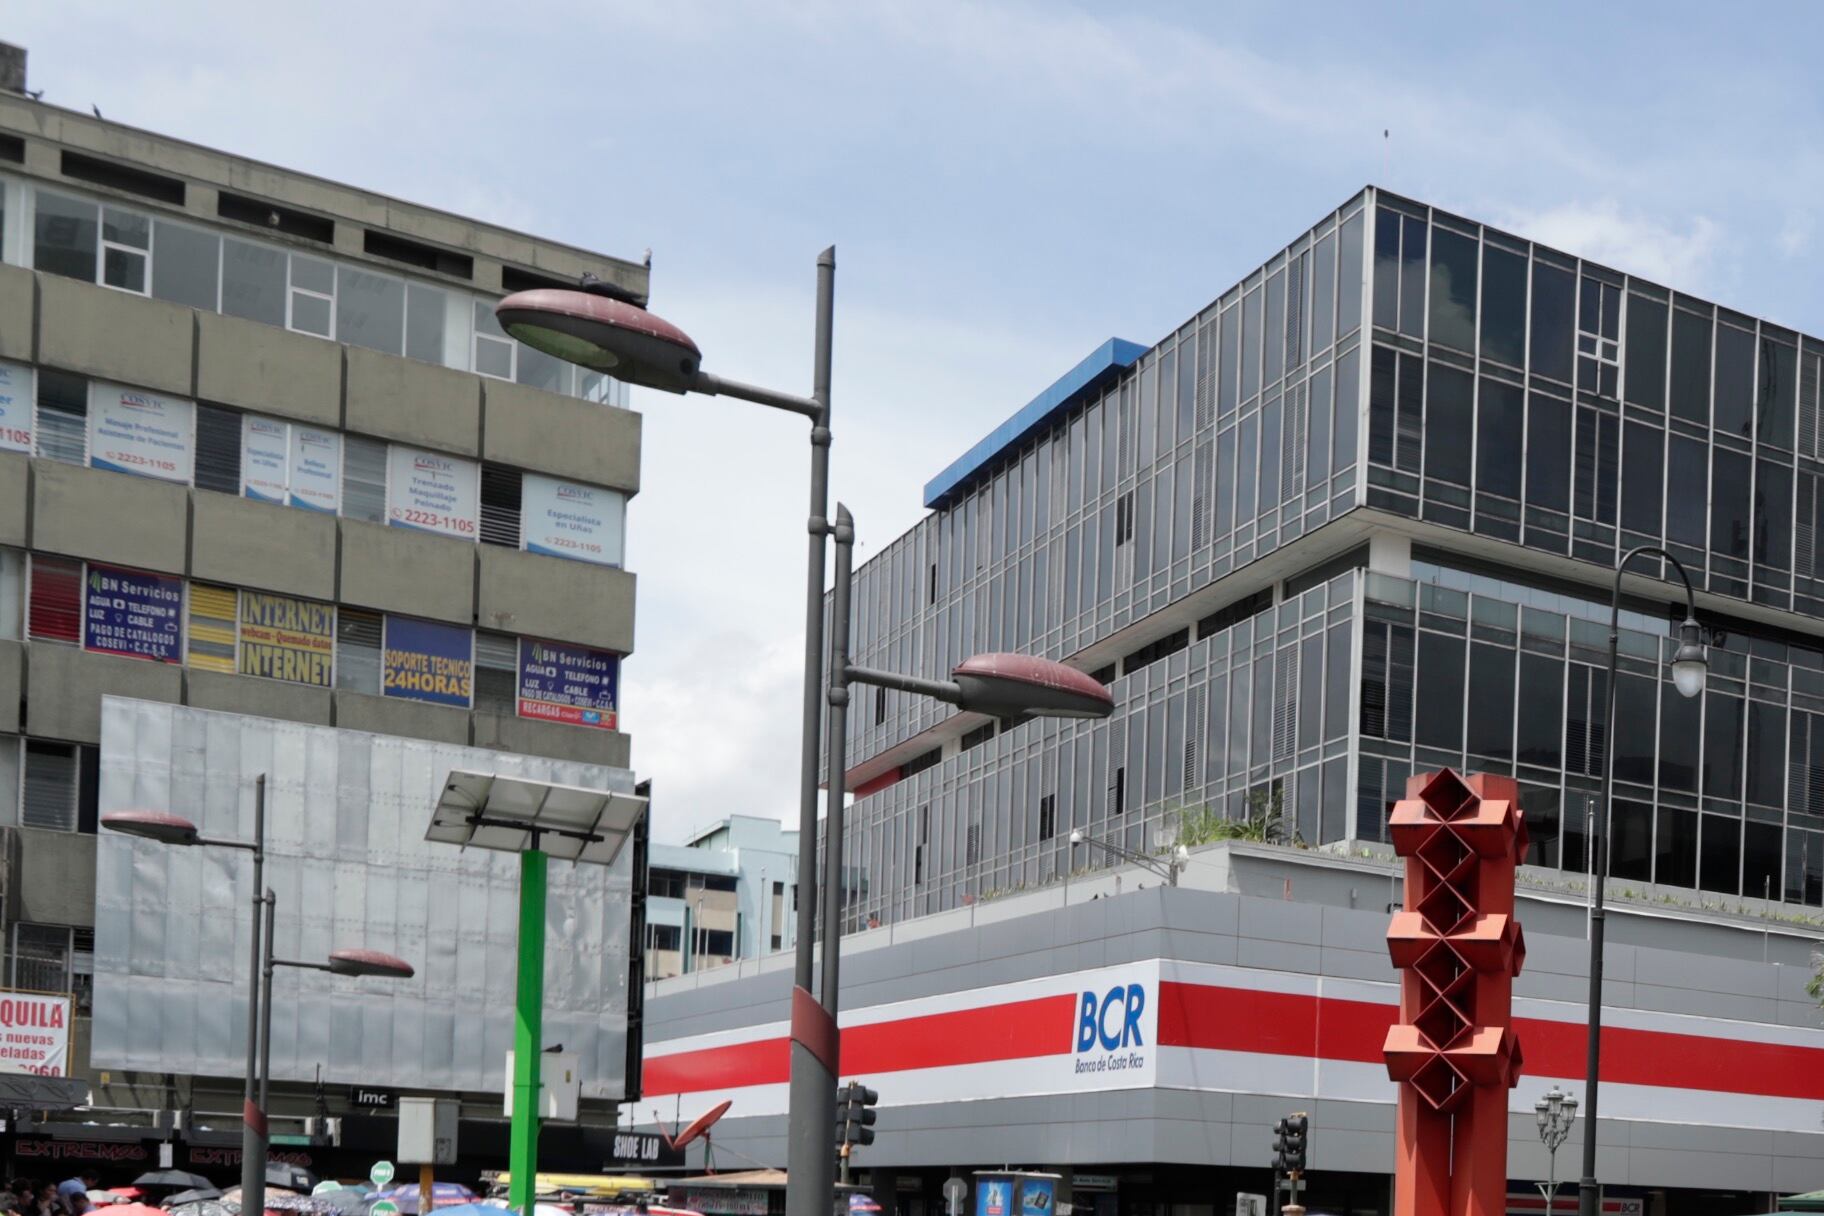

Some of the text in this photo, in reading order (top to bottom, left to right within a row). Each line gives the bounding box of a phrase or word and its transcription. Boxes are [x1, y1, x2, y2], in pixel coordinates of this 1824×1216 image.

[117, 452, 176, 471] 2223-1105
[405, 509, 474, 533] 2223-1105
[547, 509, 601, 526] Especialista
[102, 577, 179, 602] BN Servicios
[89, 595, 166, 617] AGUA TELEFONO
[242, 592, 333, 636] INTERNET
[89, 609, 154, 628] LUZ CABLE
[90, 623, 112, 636] PAGO
[114, 627, 125, 638] DE
[96, 636, 127, 650] COSEVI
[240, 642, 331, 686] INTERNET
[385, 649, 471, 677] SOPORTE TECNICO
[543, 650, 607, 671] BN Servicios
[526, 664, 600, 685] AGUA TELEFONO
[525, 678, 588, 696] LUZ CABLE
[523, 702, 560, 718] RECARGAS
[1077, 983, 1145, 1053] BCR
[6, 1032, 54, 1046] nuevas
[1075, 1052, 1144, 1074] Banco de Costa Rica
[613, 1134, 660, 1160] SHOE LAB
[1621, 1201, 1640, 1213] BCR
